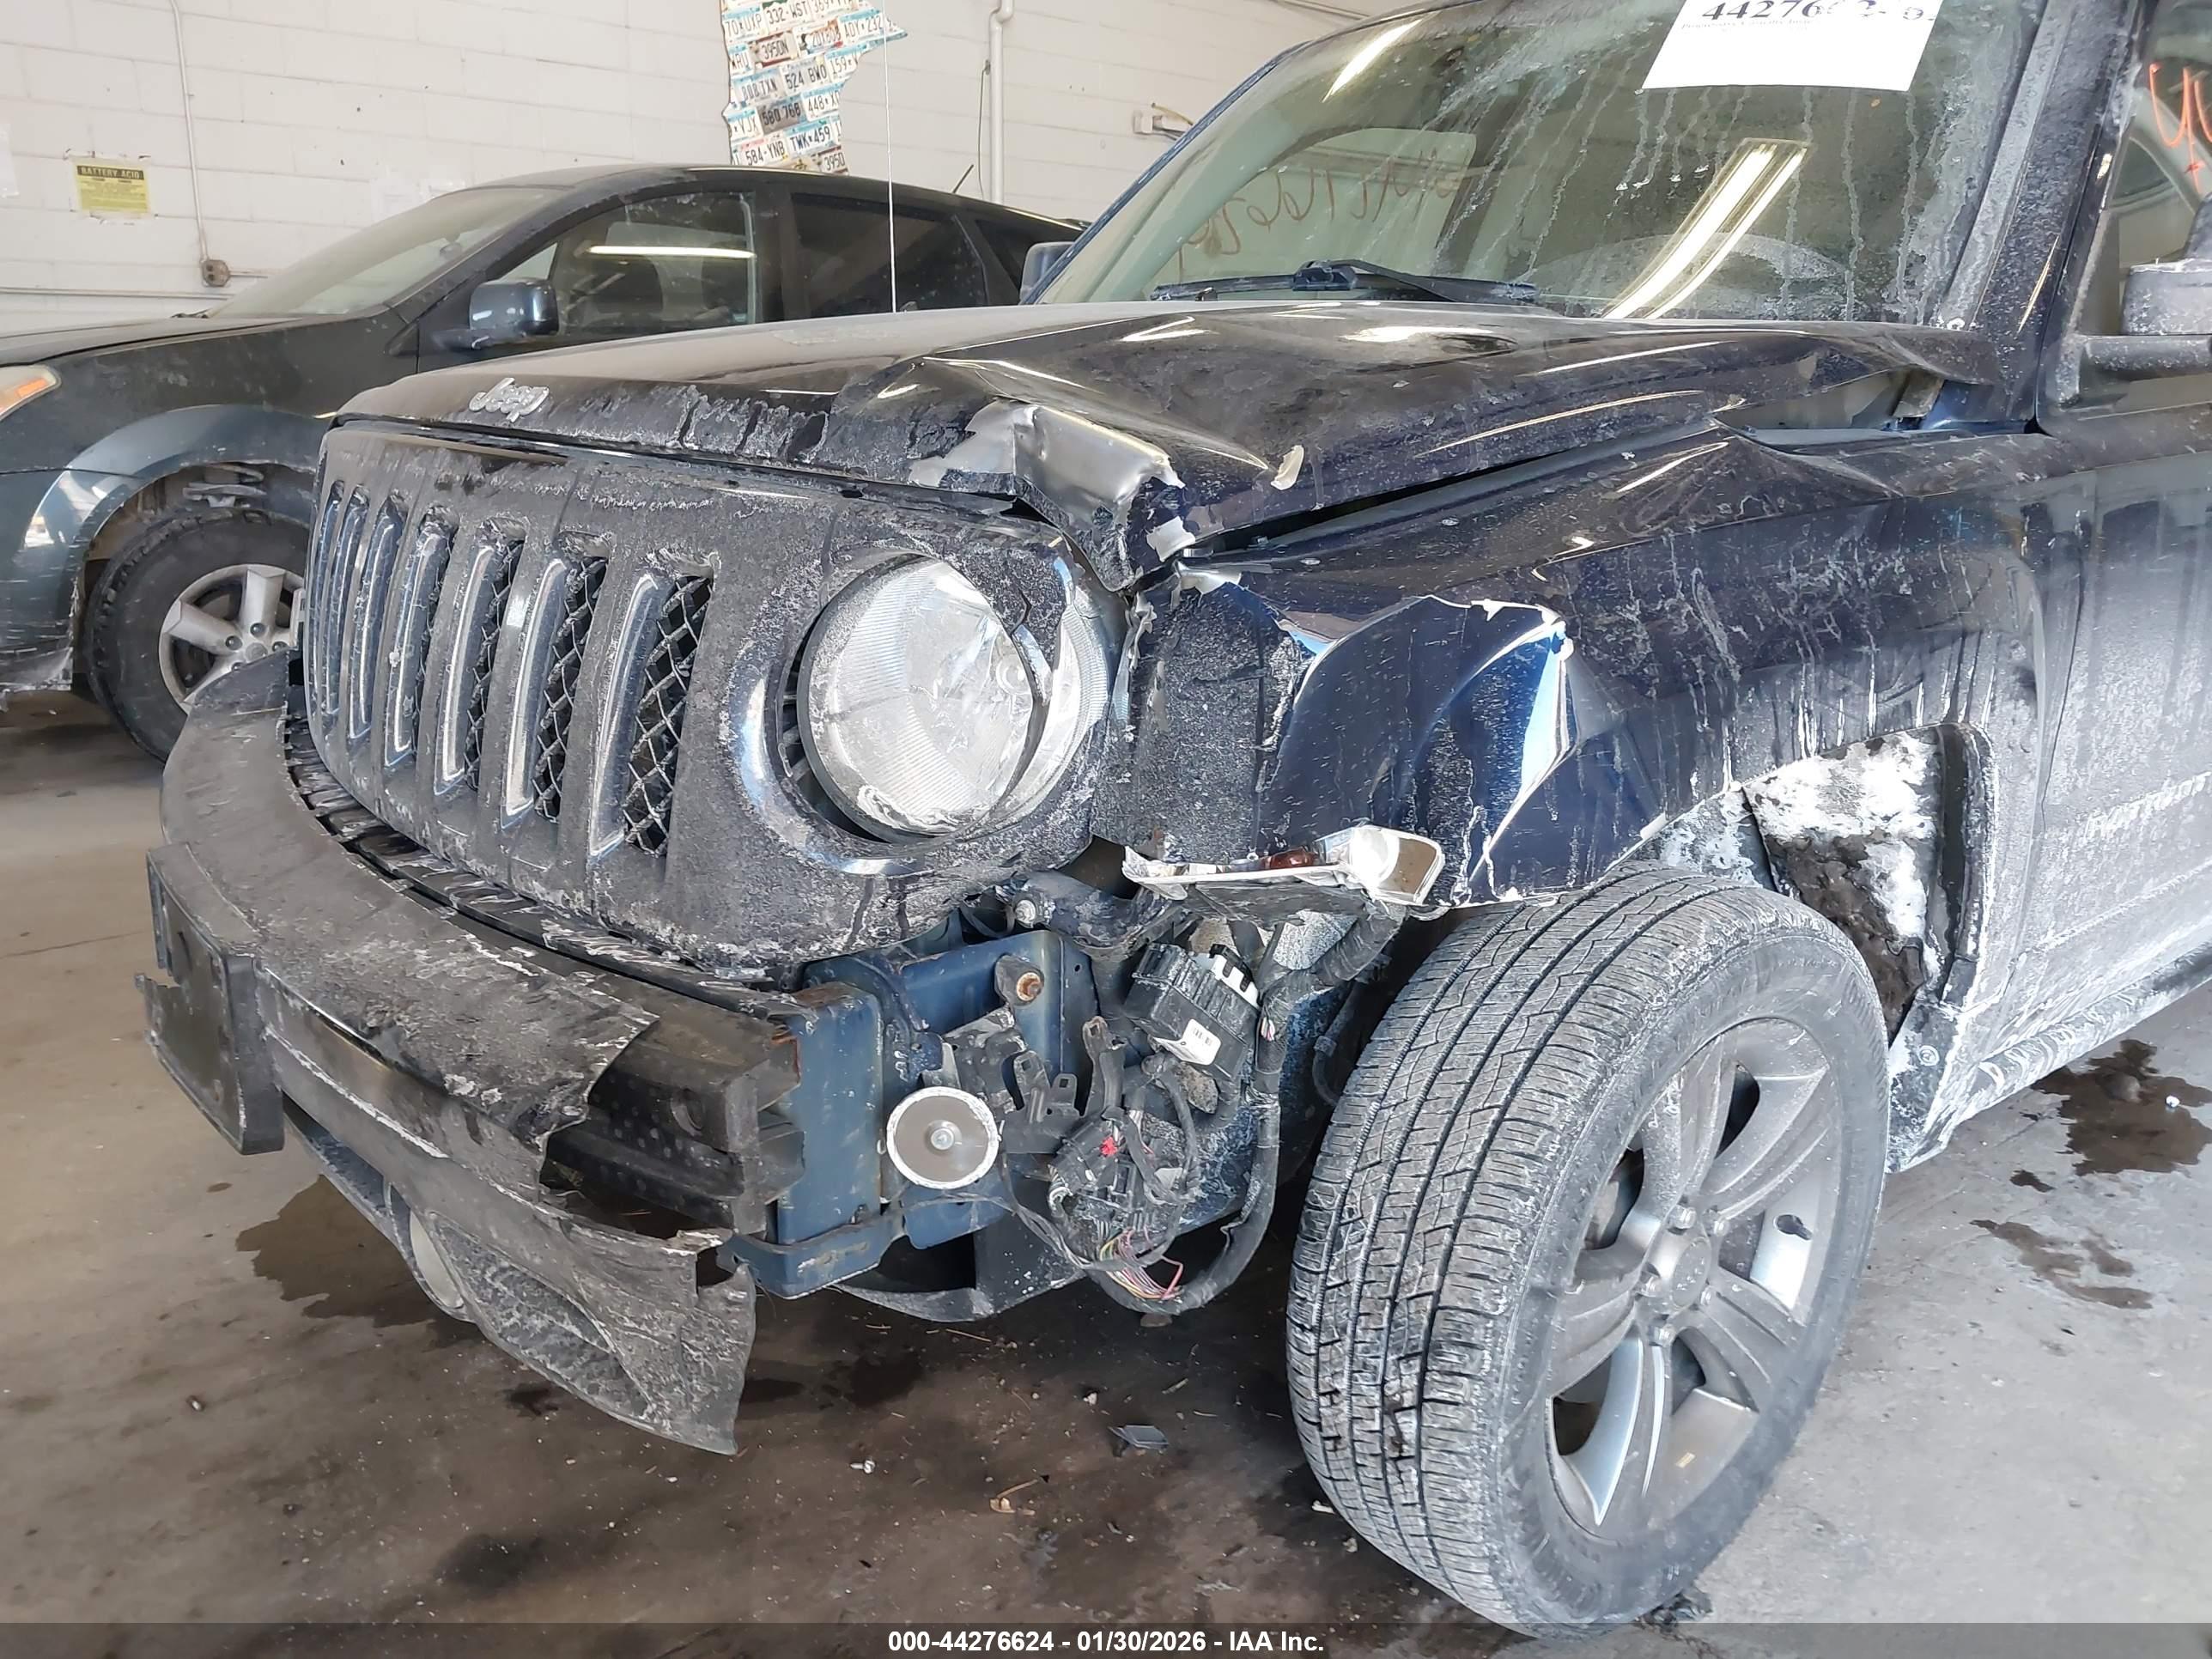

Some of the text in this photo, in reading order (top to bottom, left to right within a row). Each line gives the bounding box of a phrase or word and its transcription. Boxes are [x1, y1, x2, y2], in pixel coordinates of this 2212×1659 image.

[81, 167, 141, 179] BATTERY ACID
[469, 377, 550, 423] Jeep
